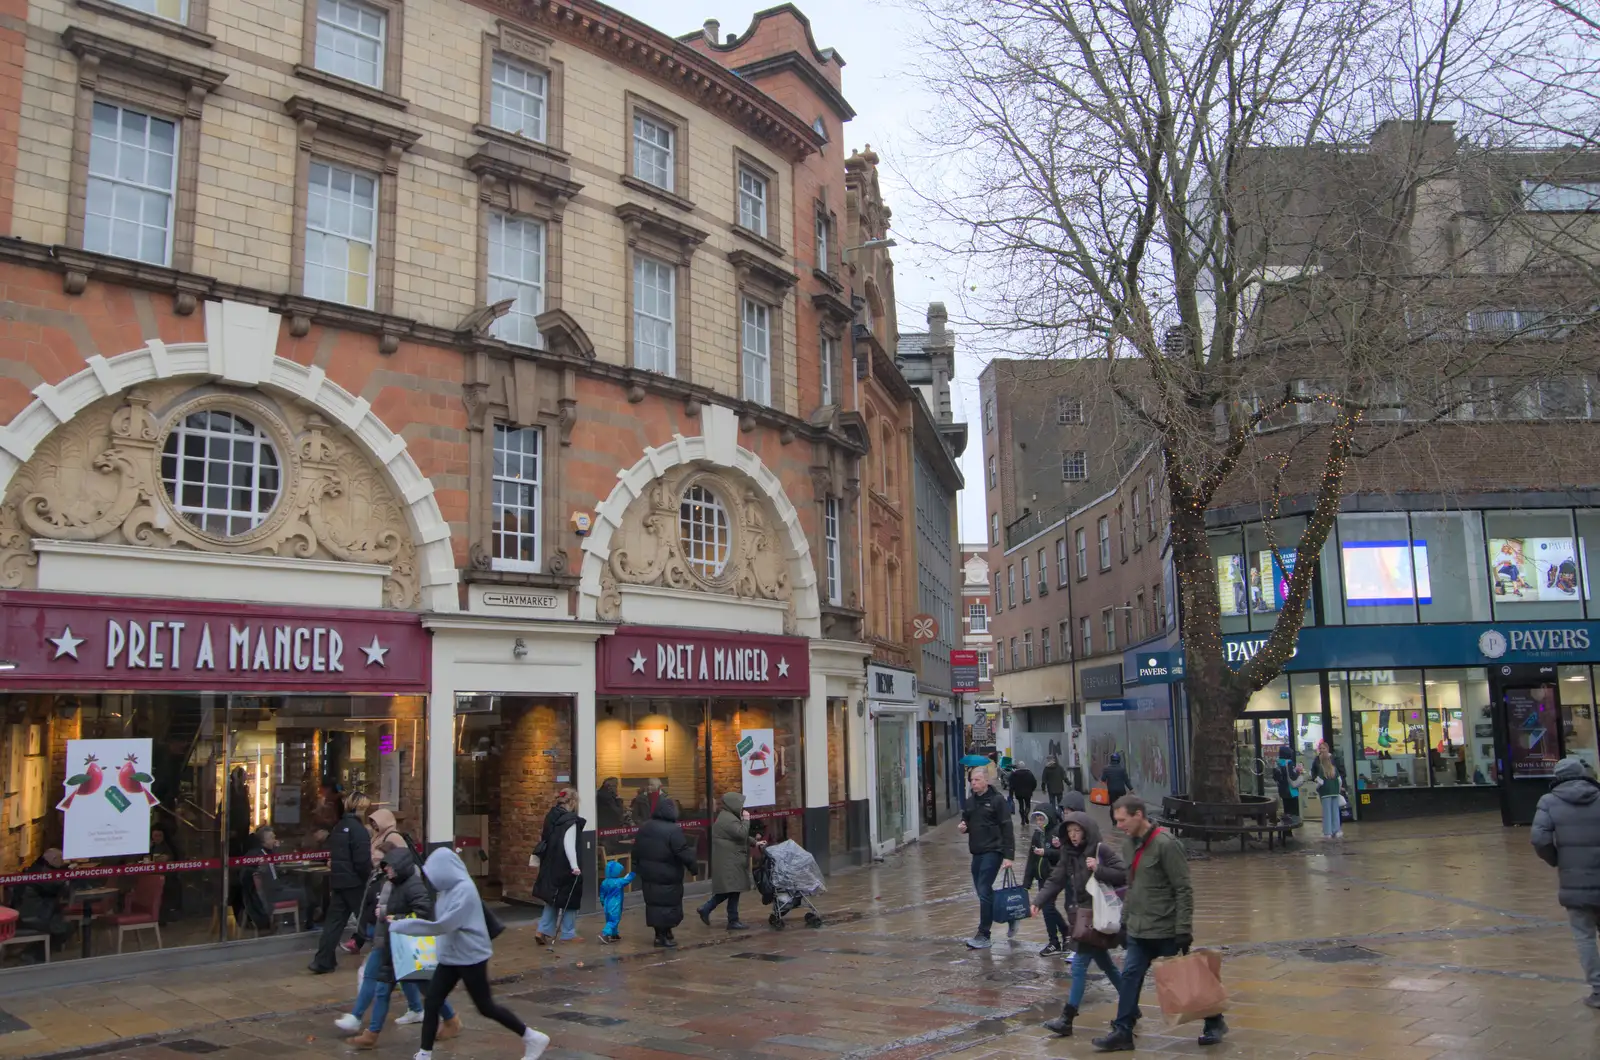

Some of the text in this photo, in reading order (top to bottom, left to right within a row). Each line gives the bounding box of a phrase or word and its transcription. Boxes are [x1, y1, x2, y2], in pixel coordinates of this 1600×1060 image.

[502, 594, 554, 606] HAYMARKET
[106, 619, 344, 672] PRET A MANGER
[1508, 628, 1591, 650] PAVERS
[656, 642, 769, 682] PRET A MANGER
[1139, 667, 1168, 677] PAVERS
[302, 851, 330, 859] BAGUETT
[0, 861, 202, 884] SANDWICHES CAPPUCCINO COOKIES ESPRESSO
